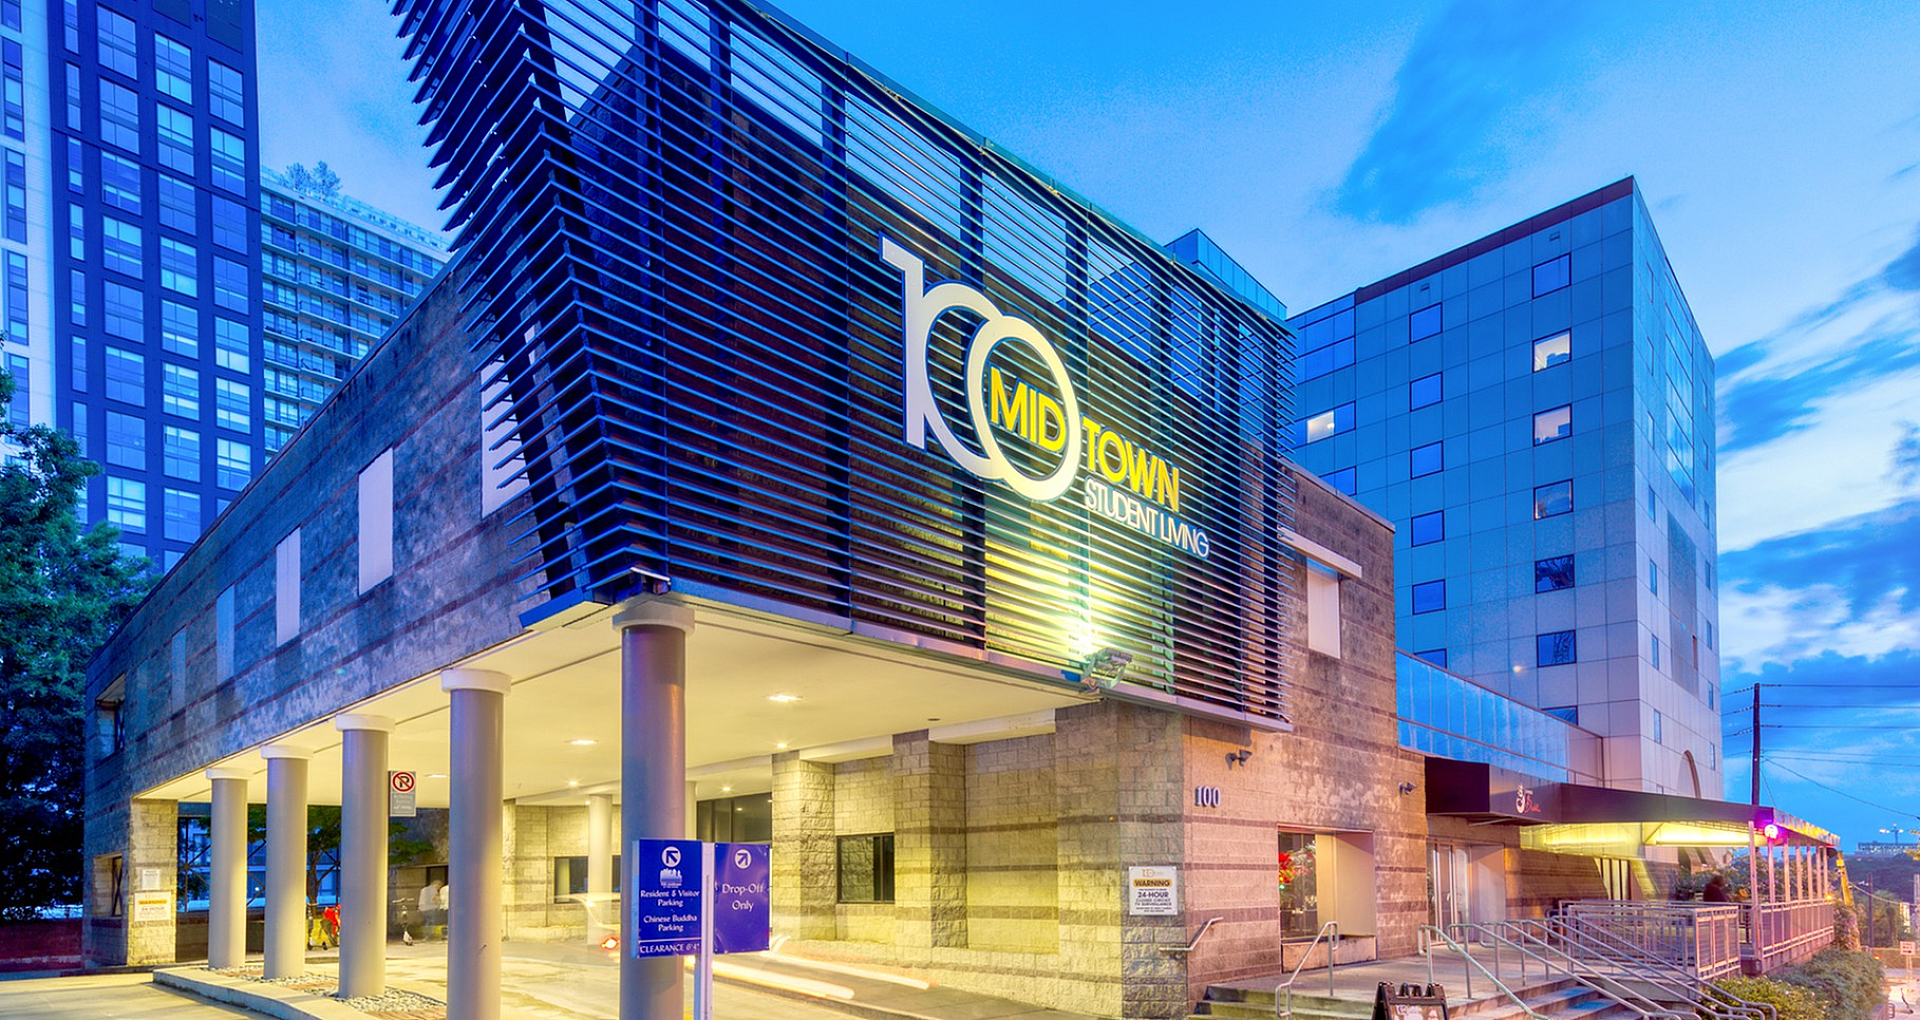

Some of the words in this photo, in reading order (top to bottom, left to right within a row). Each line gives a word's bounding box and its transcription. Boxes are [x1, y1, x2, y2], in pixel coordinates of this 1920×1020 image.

[989, 366, 1067, 453] MID
[1082, 415, 1180, 513] TOWN
[1084, 478, 1158, 536] STUDENT
[1159, 512, 1210, 558] LIVING
[1195, 786, 1220, 808] 100
[1135, 879, 1170, 887] WARNING
[640, 889, 669, 898] Resident
[678, 889, 700, 897] Visitor
[722, 883, 764, 896] Drop-Off
[658, 898, 683, 907] Parking
[732, 899, 754, 912] Only
[643, 914, 670, 923] Chinese
[672, 914, 697, 922] Buddha
[658, 923, 683, 932] Parking
[640, 943, 683, 953] CLEARANCE
